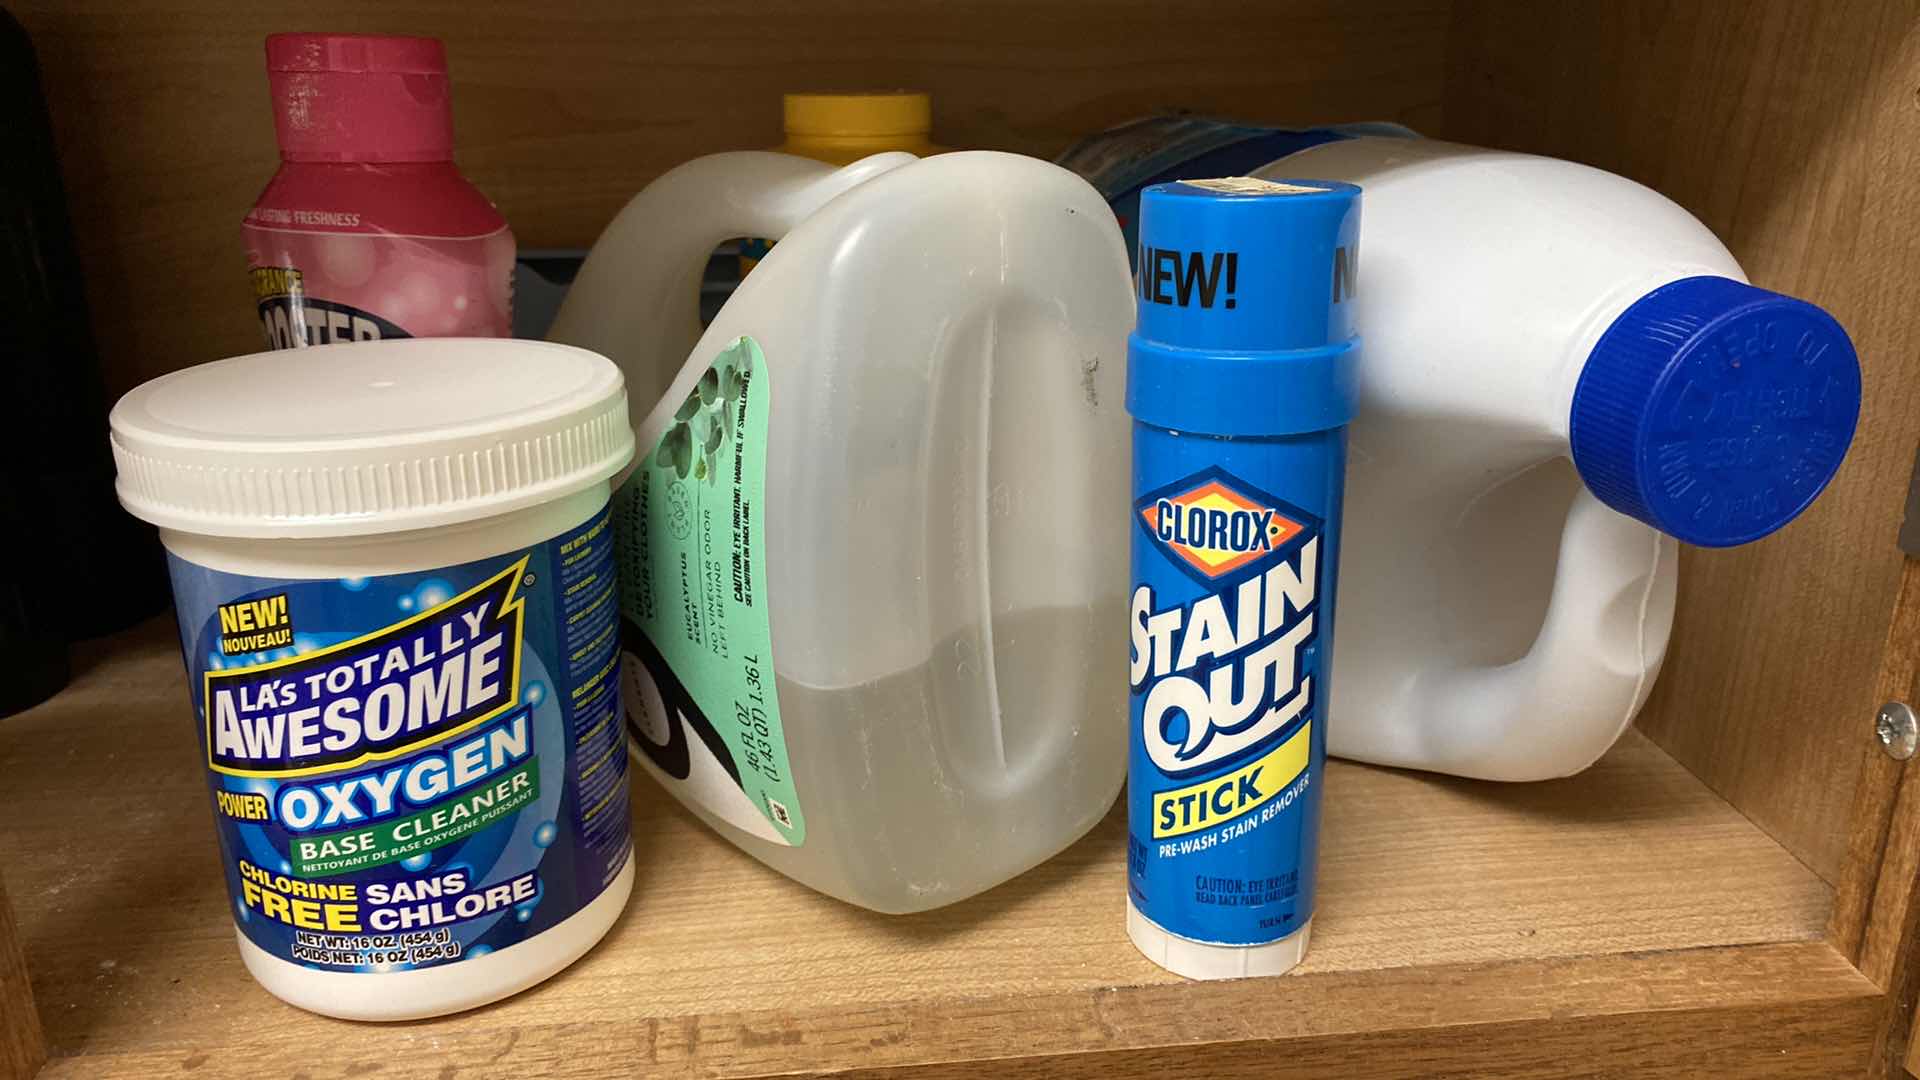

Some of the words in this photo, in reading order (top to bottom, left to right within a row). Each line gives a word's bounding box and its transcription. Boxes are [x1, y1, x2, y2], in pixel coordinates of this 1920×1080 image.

[294, 210, 361, 227] FRESHNESS
[1139, 242, 1238, 309] NEW!
[733, 440, 744, 484] HARMFUL
[733, 530, 741, 550] EYE
[1157, 499, 1273, 552] CLOROX
[681, 551, 694, 640] EUCALYPTUS
[705, 560, 715, 627] VINEGAR
[714, 561, 724, 619] BEHIND
[732, 551, 743, 603] CAUTION:
[219, 595, 288, 634] NEW!
[691, 602, 701, 645] SCENT
[1131, 535, 1317, 686] STAIN
[223, 628, 292, 653] NOUVEAU!
[304, 601, 490, 700] TOTALLY
[711, 632, 719, 654] NO
[719, 625, 729, 659] LEFT
[744, 655, 758, 665] L
[216, 632, 503, 759] AWESOME
[745, 666, 764, 705] 1.36
[1143, 611, 1313, 771] OUT
[735, 700, 751, 727] OZ
[751, 707, 769, 738] QT)
[741, 732, 757, 750] FL
[745, 749, 760, 772] 46
[757, 739, 782, 783] (1.43
[281, 716, 527, 828] OXYGEN
[217, 790, 268, 820] POWER
[300, 831, 376, 860] BASE
[392, 771, 531, 841] CLEANER
[1159, 833, 1217, 858] PRE-WASH
[1221, 815, 1258, 843] STAIN
[1261, 773, 1310, 824] REMOVER
[1160, 766, 1264, 830] STICK
[303, 854, 368, 872] NETTOYANT
[372, 850, 389, 862] DE
[390, 841, 421, 859] BASE
[481, 788, 534, 823] PUISSANT
[240, 859, 357, 900] CHLORINE
[366, 873, 466, 905] SANS
[1196, 874, 1246, 893] CAUTION:
[1248, 880, 1264, 893] EYE
[242, 878, 362, 932] FREE
[370, 874, 535, 931] CHLORE
[293, 946, 330, 962] POIDS
[333, 951, 363, 964] NET:
[368, 952, 384, 964] 16
[388, 951, 407, 962] OZ
[412, 947, 442, 962] (454
[446, 943, 460, 957] g)
[298, 932, 323, 948] NET
[354, 937, 369, 949] 16
[401, 933, 432, 948] (454
[436, 928, 449, 944] g)
